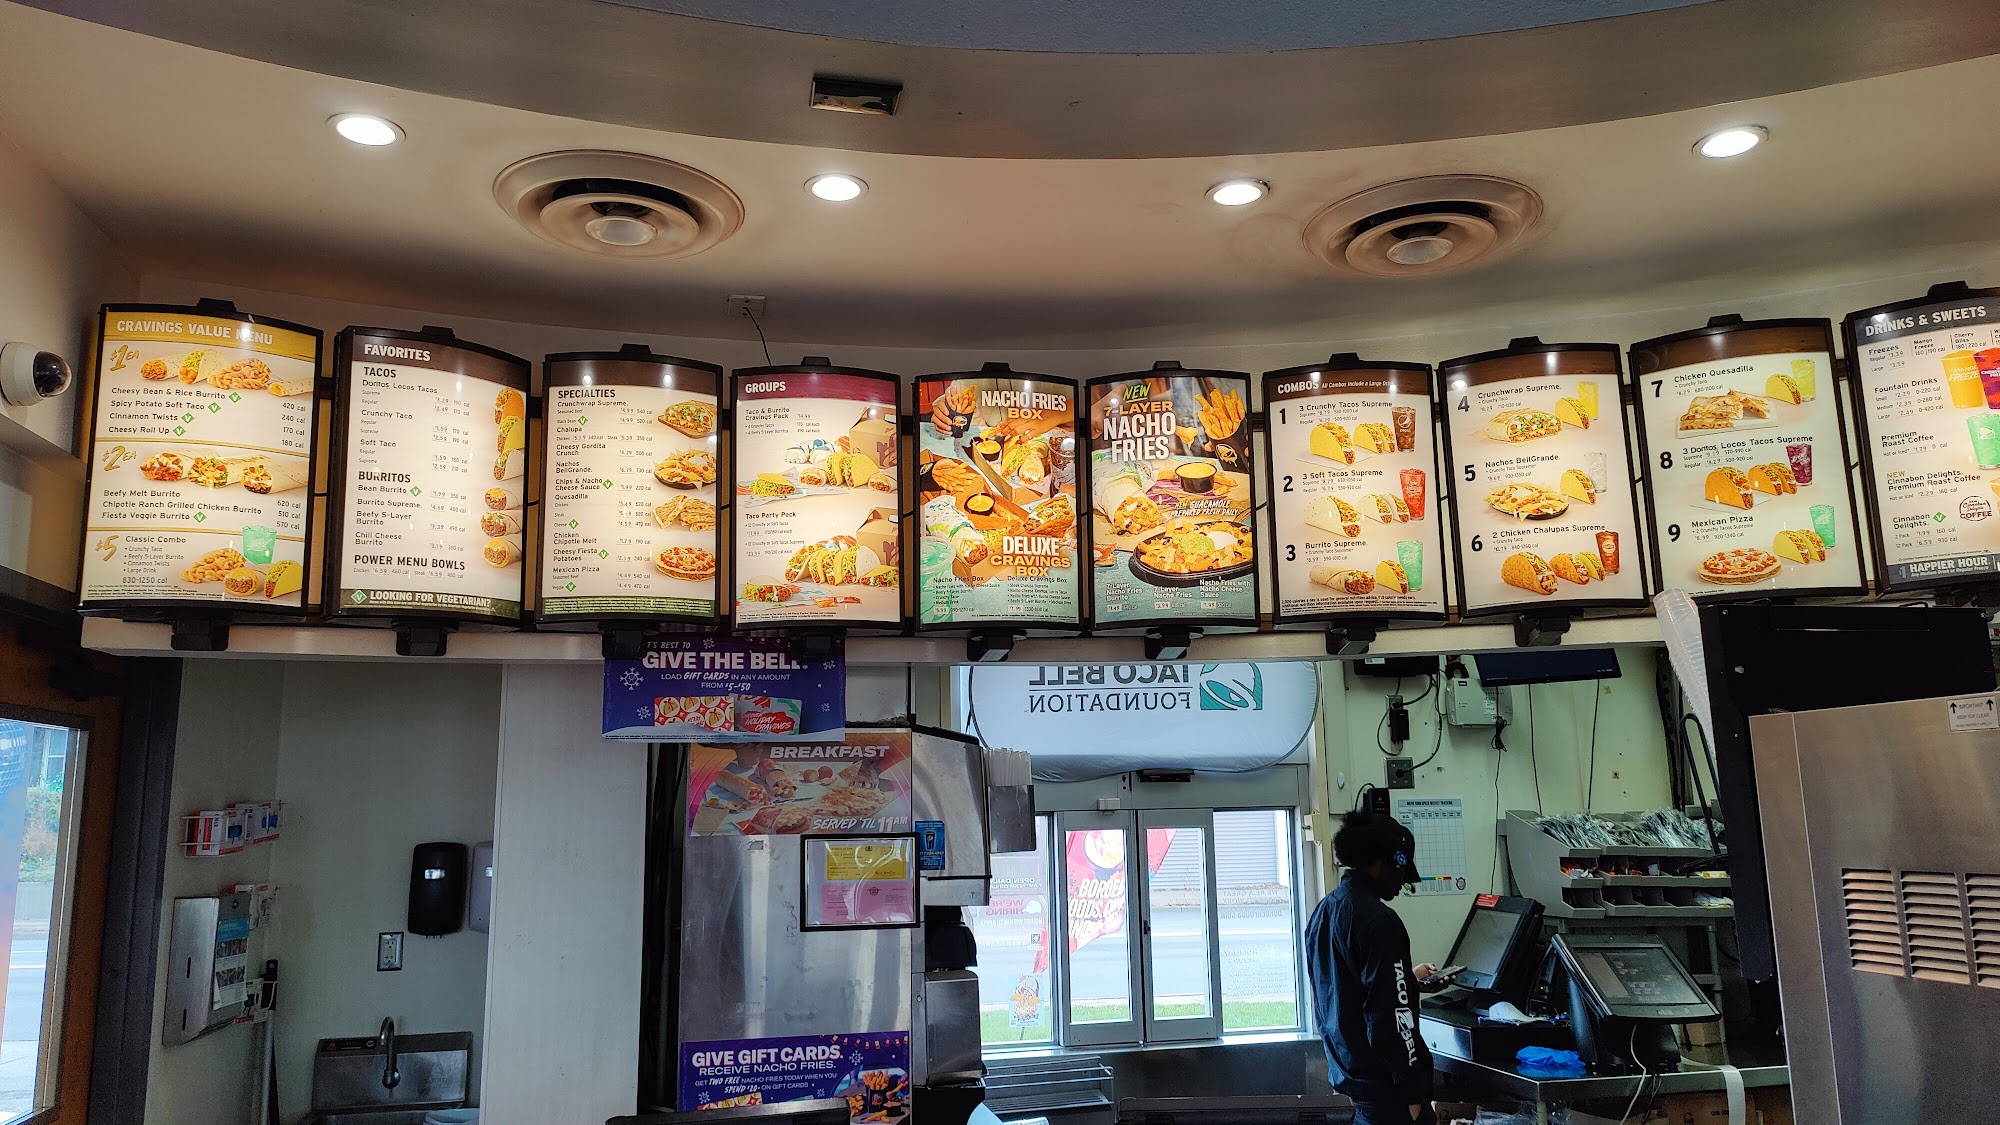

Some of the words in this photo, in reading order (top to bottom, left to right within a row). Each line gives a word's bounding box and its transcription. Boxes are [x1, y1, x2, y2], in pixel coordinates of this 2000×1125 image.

[1865, 317, 1914, 336] DRINKS
[1919, 314, 1928, 326] &
[1933, 306, 1986, 323] SWEETS
[117, 321, 183, 333] CRAVINGS
[188, 324, 230, 338] VALUE
[236, 329, 273, 345] MENU
[364, 344, 431, 361] FAVORITES
[1868, 345, 1899, 355] Freezes
[364, 367, 396, 378] TACOS
[745, 382, 786, 393] GROUPS
[1278, 380, 1319, 394] COMBOS
[1651, 380, 1663, 397] 7
[1674, 372, 1706, 383] Chicken
[1709, 365, 1754, 377] Quesadilla
[1874, 383, 1908, 393] Fountain
[1912, 378, 1938, 386] Drinks
[111, 388, 140, 396] Cheesy
[143, 388, 164, 396] Bean
[175, 389, 193, 397] Rice
[196, 390, 226, 399] Burrito
[558, 389, 615, 398] SPECIALTIES
[1123, 383, 1151, 400] NEW
[111, 400, 132, 409] Spicy
[186, 402, 205, 410] Taco
[981, 391, 1031, 407] NACHO
[1033, 393, 1067, 411] FRIES
[1307, 403, 1336, 411] Crunchy
[1458, 396, 1470, 412] 4
[1478, 388, 1524, 399] Crunchwrap
[297, 404, 306, 412] cal
[361, 410, 393, 419] Crunchy
[1008, 408, 1043, 420] BOX
[1279, 408, 1286, 424] 1
[1103, 412, 1176, 441] NACHO
[1721, 440, 1747, 449] Locos
[1777, 435, 1813, 443] Supreme
[1112, 436, 1169, 463] FRIES
[1660, 452, 1673, 469] 8
[1465, 464, 1476, 481] 5
[1485, 458, 1513, 468] Nachos
[358, 471, 411, 483] BURRITOS
[1283, 476, 1293, 492] 2
[103, 490, 126, 498] Beefy
[151, 490, 180, 498] Burrito
[103, 501, 135, 510] Chipotle
[198, 503, 230, 512] Chicken
[233, 506, 262, 514] Burrito
[1190, 500, 1232, 509] GUACAMOLE
[1960, 511, 1992, 519] COFFEE
[1500, 529, 1531, 538] Chicken
[1534, 526, 1569, 534] Chalupas
[1572, 524, 1605, 533] Supreme
[1668, 524, 1681, 542] 9
[1692, 518, 1726, 527] Mexican
[1003, 536, 1059, 556] DELUXE
[1471, 534, 1483, 551] 6
[1285, 544, 1296, 561] 3
[1306, 541, 1331, 549] Burrito
[354, 555, 393, 565] POWER
[397, 556, 427, 567] MENU
[432, 559, 465, 570] BOWLS
[990, 555, 1070, 568] CRAVINGS
[1910, 558, 1954, 572] HAPPIER
[1016, 566, 1049, 576] BOX
[370, 591, 412, 601] LOOKING
[415, 592, 433, 602] FOR
[437, 593, 491, 607] VEGETARIAN?
[642, 652, 696, 670] GIVE
[701, 652, 745, 670] THE
[683, 672, 701, 680] GIFT
[703, 672, 729, 680] CARDS
[755, 722, 791, 731] CRAVINGS
[770, 746, 889, 758] BREAKFAST
[813, 818, 856, 830] SERVED
[1394, 959, 1408, 1004] TACO
[1401, 1030, 1417, 1066] BELL
[692, 1051, 734, 1067] GIVE
[738, 1049, 778, 1065] GIFT
[781, 1045, 844, 1062] CARDS.
[699, 1065, 750, 1076] RECEIVE
[754, 1063, 796, 1073] NACHO
[801, 1061, 836, 1070] FRIES.
[709, 1077, 723, 1085] TWO
[725, 1076, 740, 1084] FREE
[724, 1085, 745, 1094] SPEND
